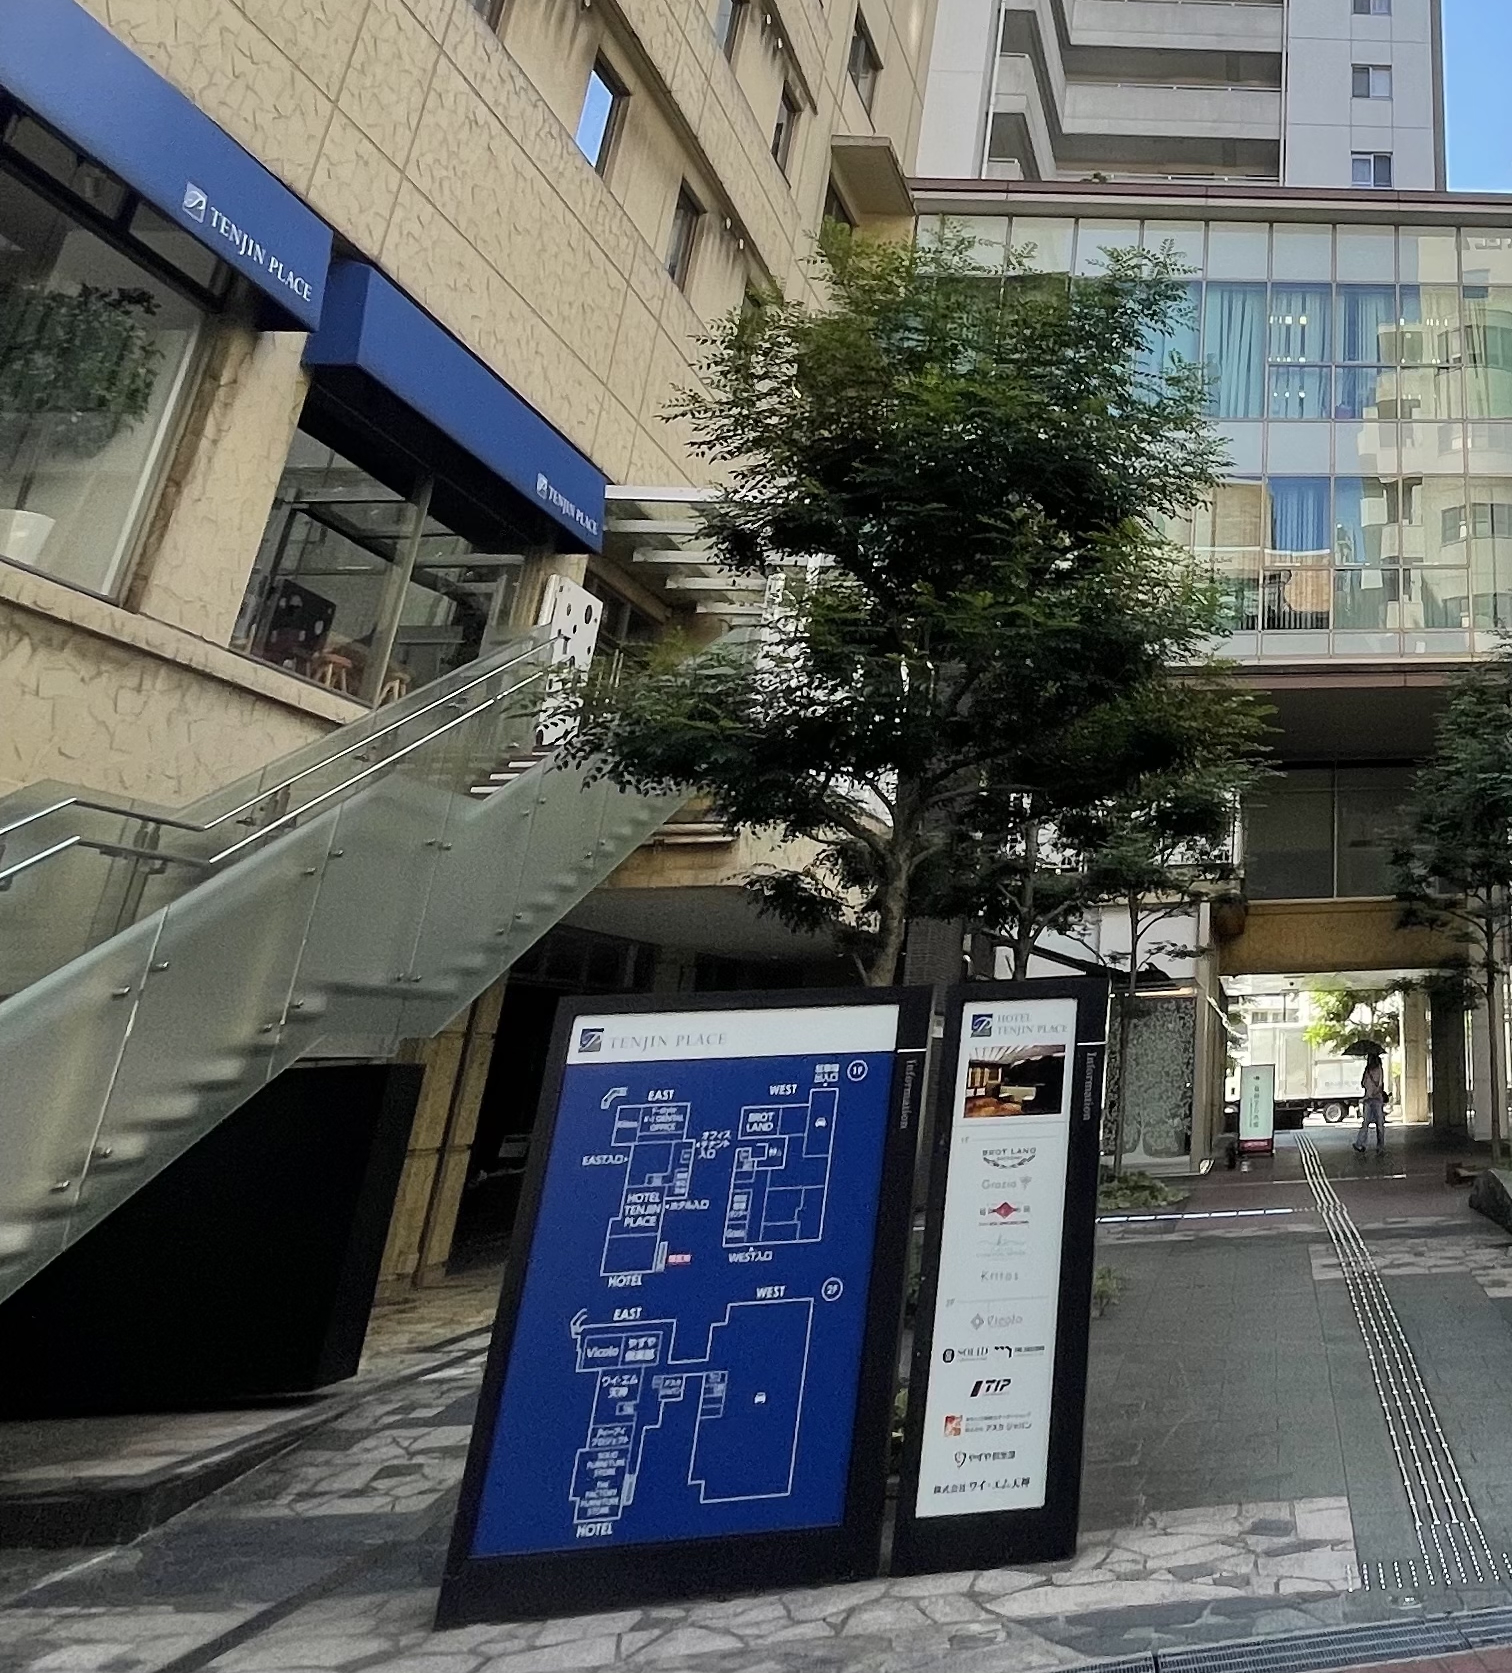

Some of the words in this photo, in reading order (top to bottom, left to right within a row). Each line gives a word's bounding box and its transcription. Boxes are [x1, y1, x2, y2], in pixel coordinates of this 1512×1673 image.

[210, 206, 266, 265] TENJIN
[268, 256, 313, 302] PLACE
[548, 485, 576, 518] TENJIN
[576, 509, 598, 535] PLACE
[608, 1036, 668, 1052] TENJIN
[675, 1032, 727, 1047] PLACE
[768, 1084, 797, 1096] WEST
[1082, 1051, 1098, 1121] Information
[647, 1089, 675, 1101] EAST
[900, 1060, 917, 1129] Information
[627, 1192, 660, 1204] HOTEL
[624, 1204, 661, 1216] TENJIN
[624, 1216, 657, 1228] PLACE
[728, 1251, 772, 1263] WEST入口
[608, 1275, 642, 1288] HOTEL
[756, 1285, 786, 1299] WEST
[613, 1307, 642, 1320] EAST
[985, 1378, 1012, 1392] TIP
[576, 1523, 613, 1538] HOTEL
